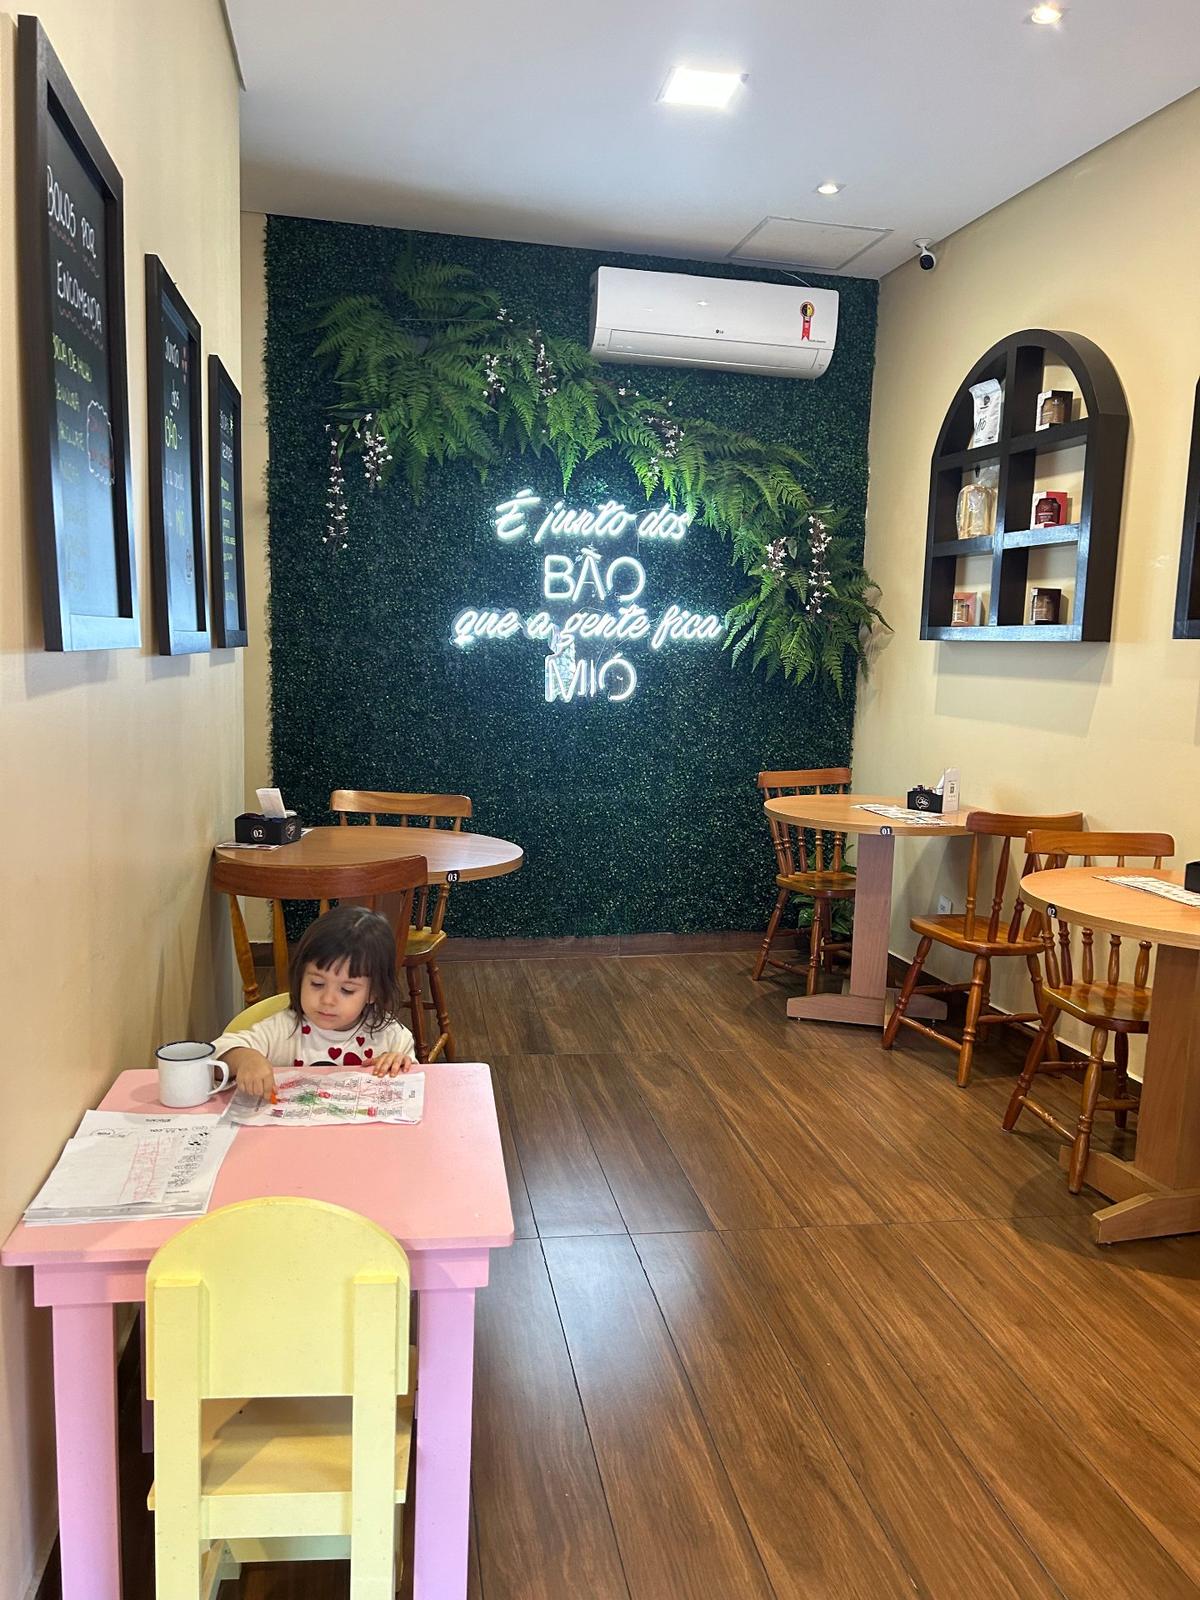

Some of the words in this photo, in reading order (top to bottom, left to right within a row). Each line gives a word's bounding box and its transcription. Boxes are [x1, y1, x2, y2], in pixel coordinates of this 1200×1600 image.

[47, 165, 77, 238] BOLOS
[56, 259, 102, 334] ENCOMENDA
[534, 500, 638, 543] junto
[638, 502, 692, 540] dos
[544, 546, 647, 601] BÃO
[452, 606, 521, 648] que
[527, 611, 552, 639] a
[557, 603, 652, 648] gente
[651, 603, 724, 650] fica
[253, 829, 264, 838] 02
[881, 827, 890, 836] 01
[447, 872, 458, 882] 03
